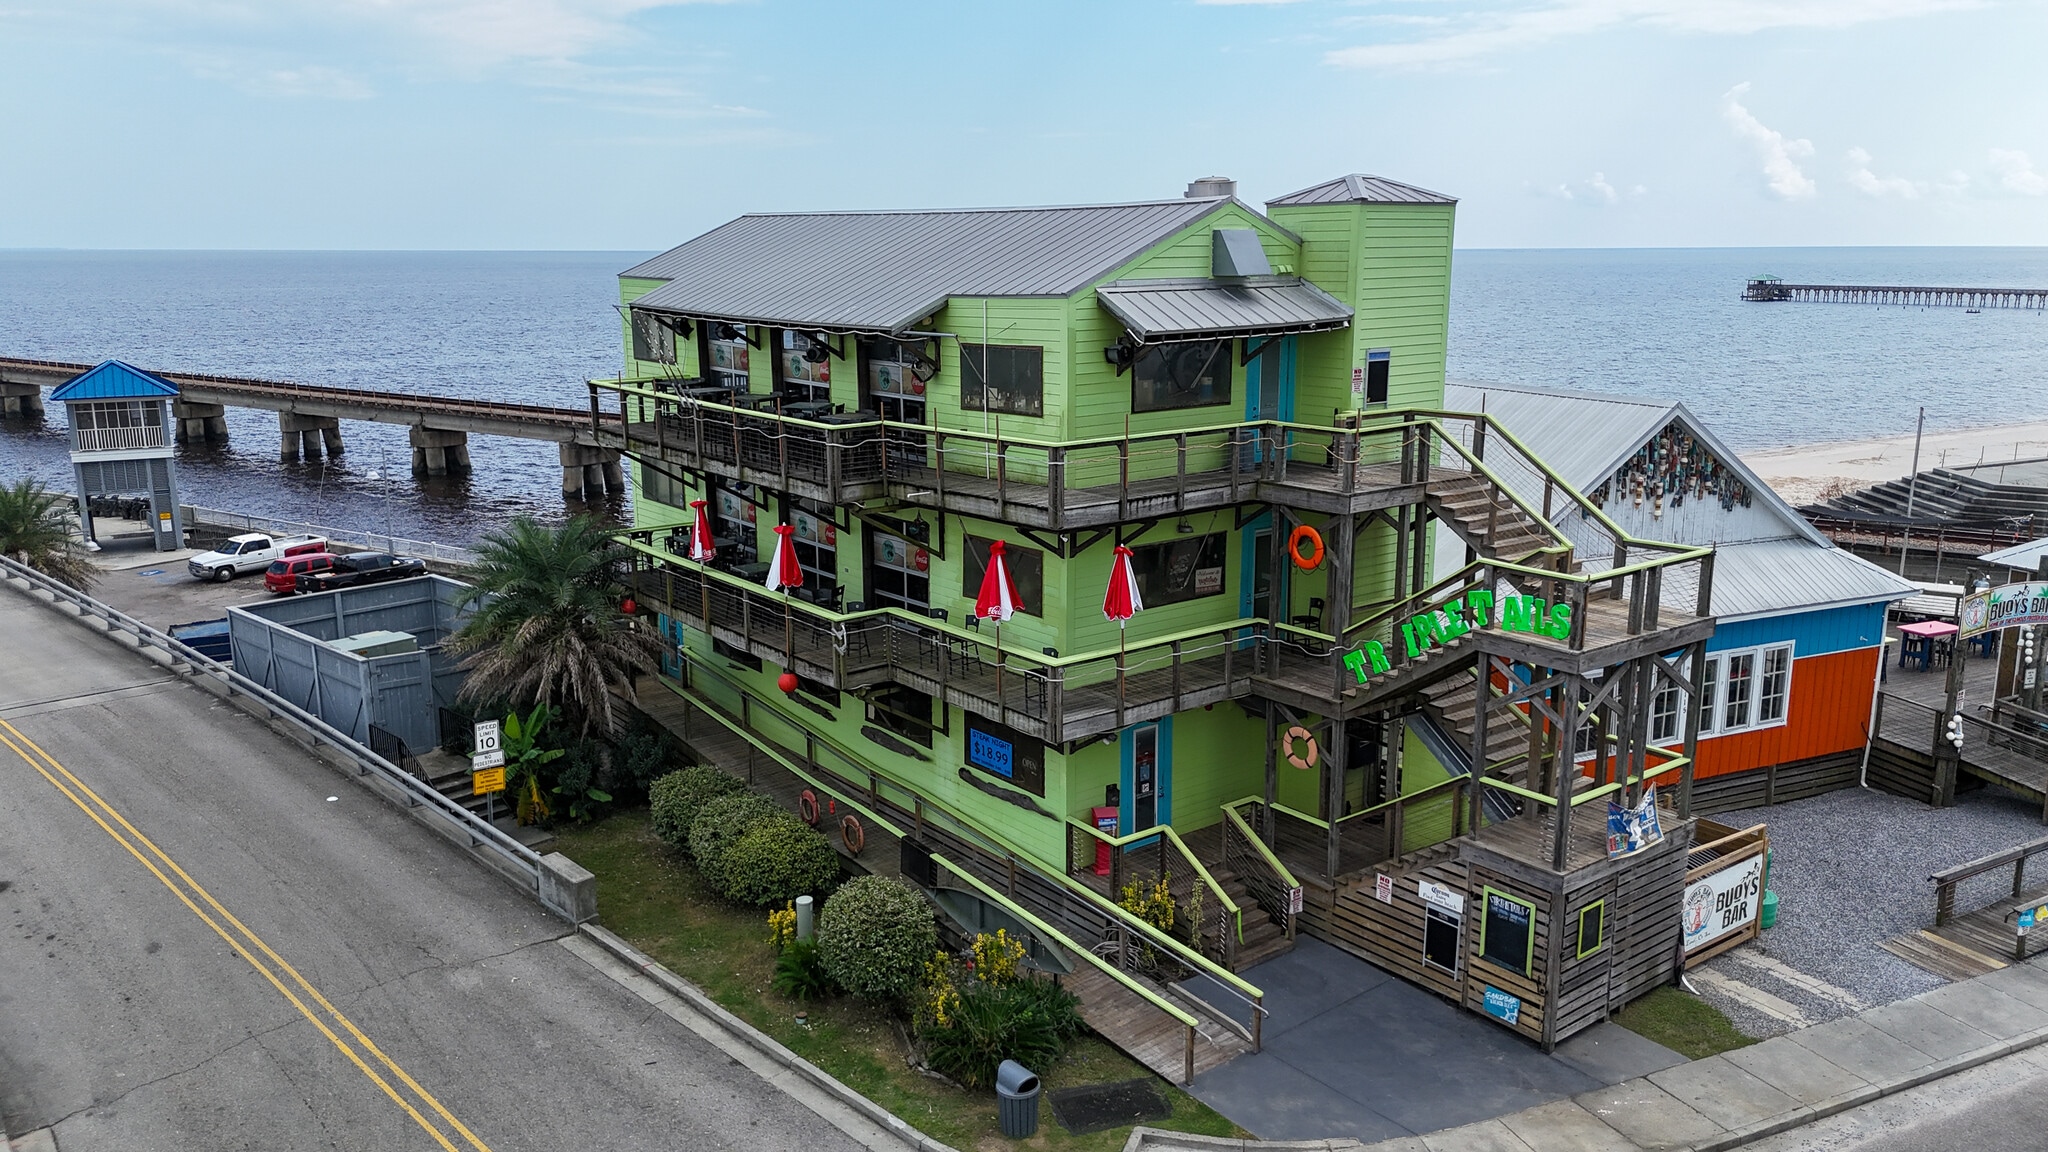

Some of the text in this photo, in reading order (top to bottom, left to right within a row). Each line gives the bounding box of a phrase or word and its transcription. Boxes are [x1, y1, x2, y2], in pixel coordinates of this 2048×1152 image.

[1990, 598, 2028, 621] BUOYS
[2031, 597, 2048, 613] BA
[477, 723, 497, 732] SPEED
[480, 737, 495, 749] 10
[972, 730, 1010, 751] STEAK NIGHT
[474, 758, 502, 767] PEDESTRIANS
[974, 740, 1008, 765] $18.99
[1380, 875, 1390, 885] NO
[1715, 876, 1759, 913] BUOYS
[1722, 901, 1748, 929] BAR
